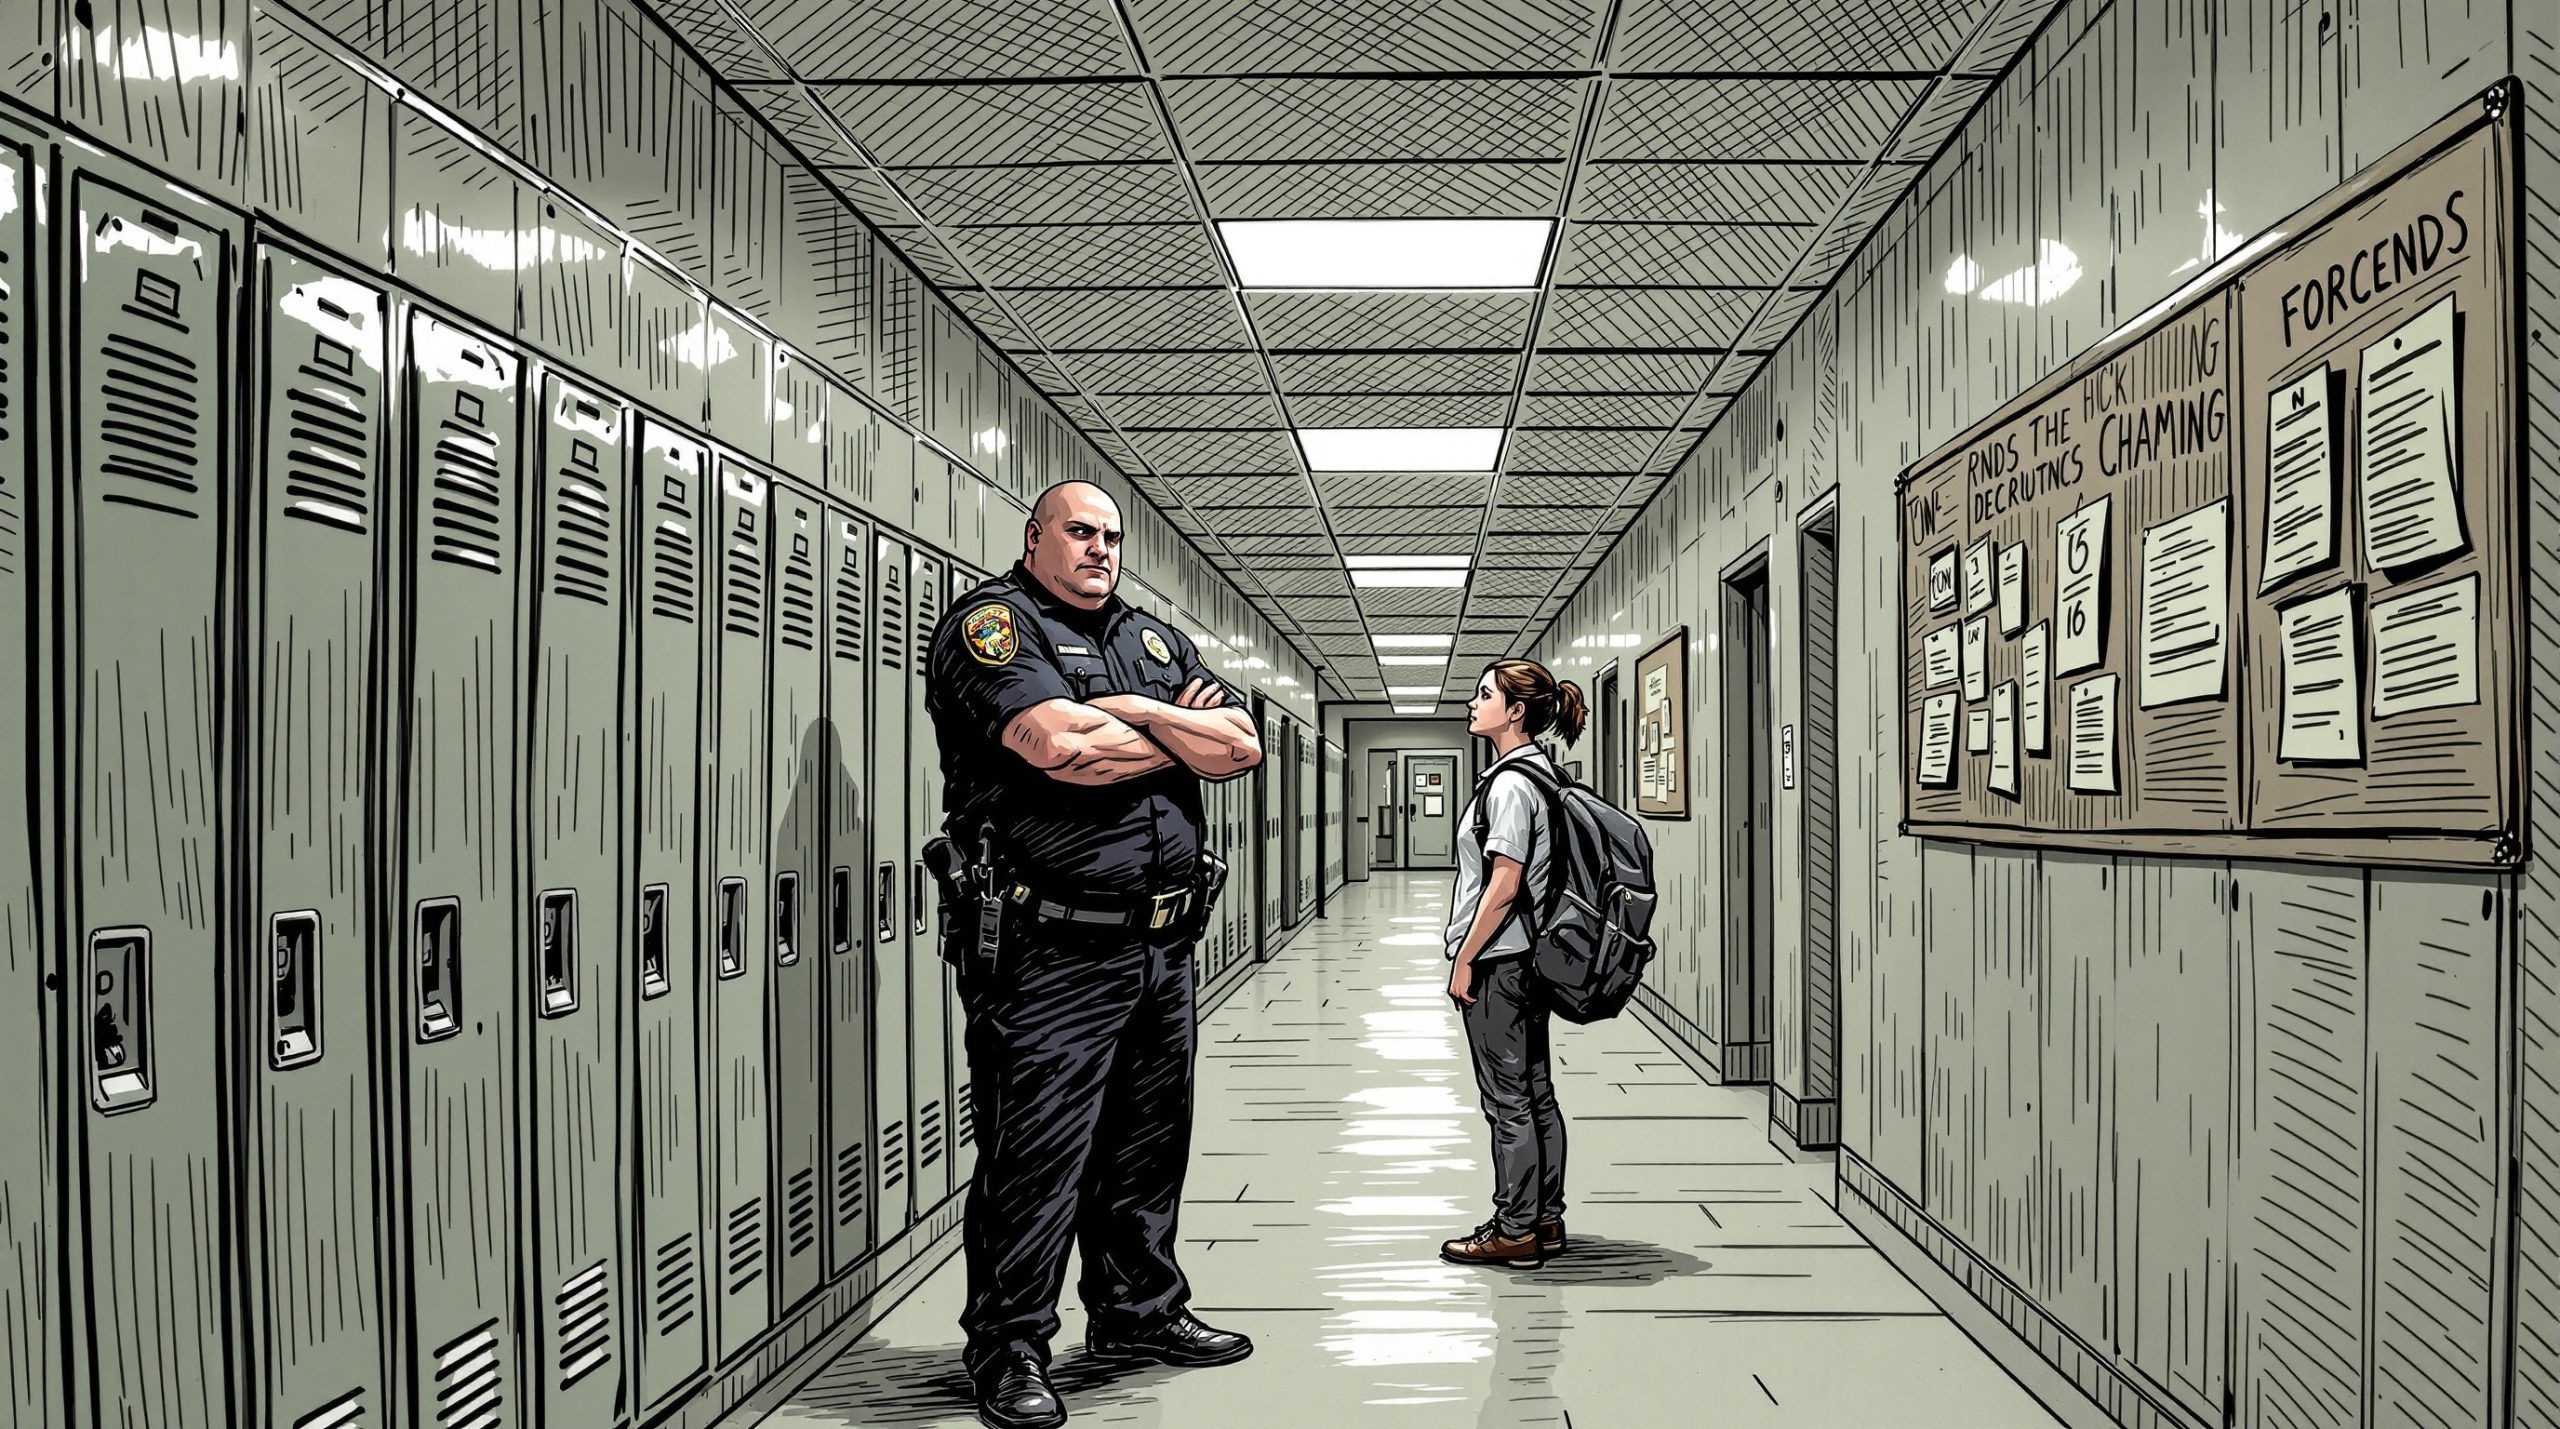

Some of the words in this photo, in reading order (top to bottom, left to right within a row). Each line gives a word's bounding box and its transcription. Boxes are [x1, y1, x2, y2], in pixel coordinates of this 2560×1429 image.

[2281, 190, 2468, 348] FORCENDS
[2029, 407, 2071, 457] THE
[2099, 388, 2226, 477] CHAMING
[2067, 600, 2086, 639] 16
